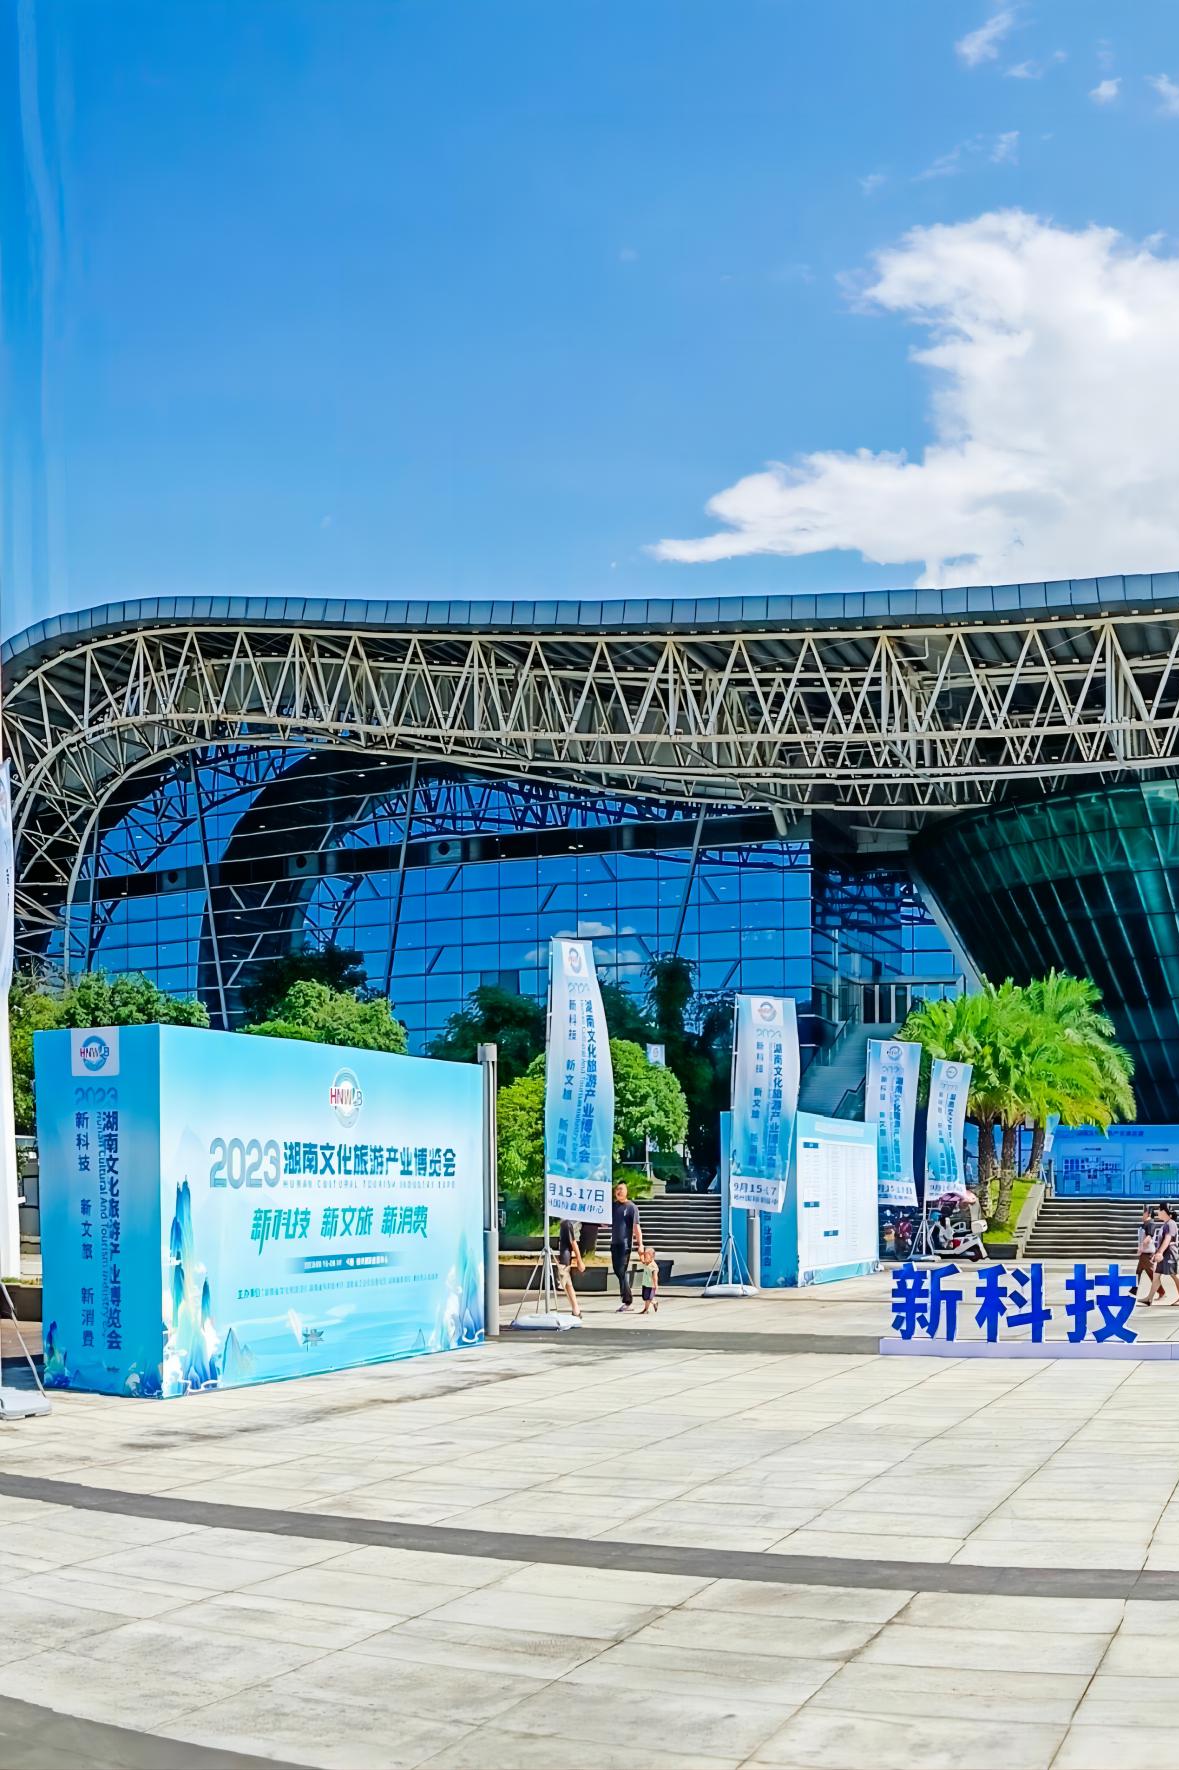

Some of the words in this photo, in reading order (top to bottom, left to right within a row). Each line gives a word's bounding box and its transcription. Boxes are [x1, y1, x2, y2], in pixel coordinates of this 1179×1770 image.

[209, 1137, 281, 1190] 2023
[283, 1141, 457, 1177] 湖南文化旅游产业博览会
[251, 1207, 312, 1256] 新科技
[320, 1205, 374, 1240] 新文旅
[381, 1204, 429, 1239] 新消费
[891, 1262, 1138, 1344] 新科技
